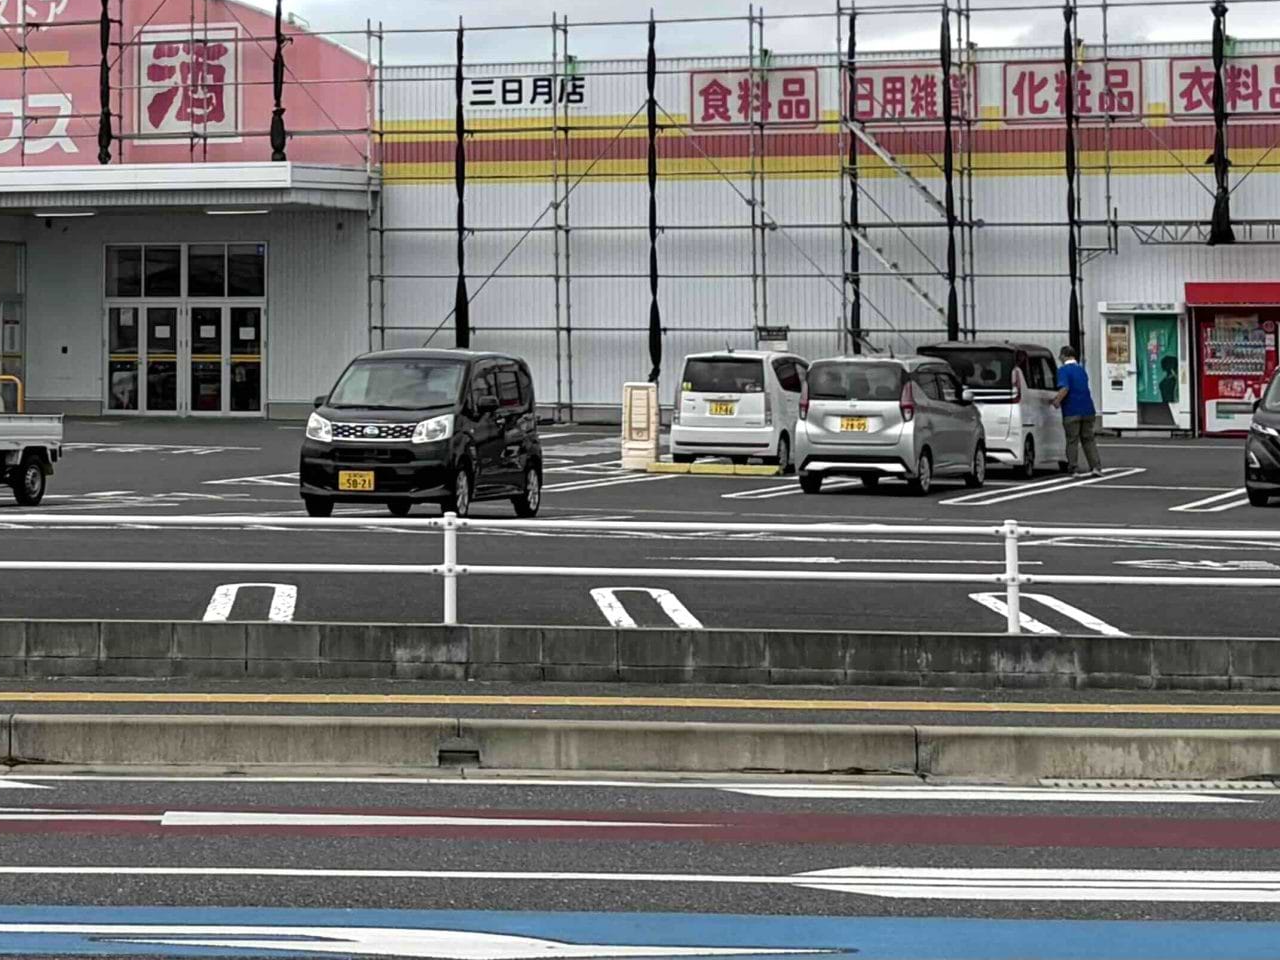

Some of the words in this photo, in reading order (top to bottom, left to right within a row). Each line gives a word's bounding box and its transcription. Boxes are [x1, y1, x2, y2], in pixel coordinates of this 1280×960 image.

[147, 42, 228, 129] 酒
[469, 77, 585, 106] 三日月店
[698, 76, 811, 122] 食料品
[1012, 69, 1134, 116] 化粧品
[1179, 63, 1280, 112] 衣料
